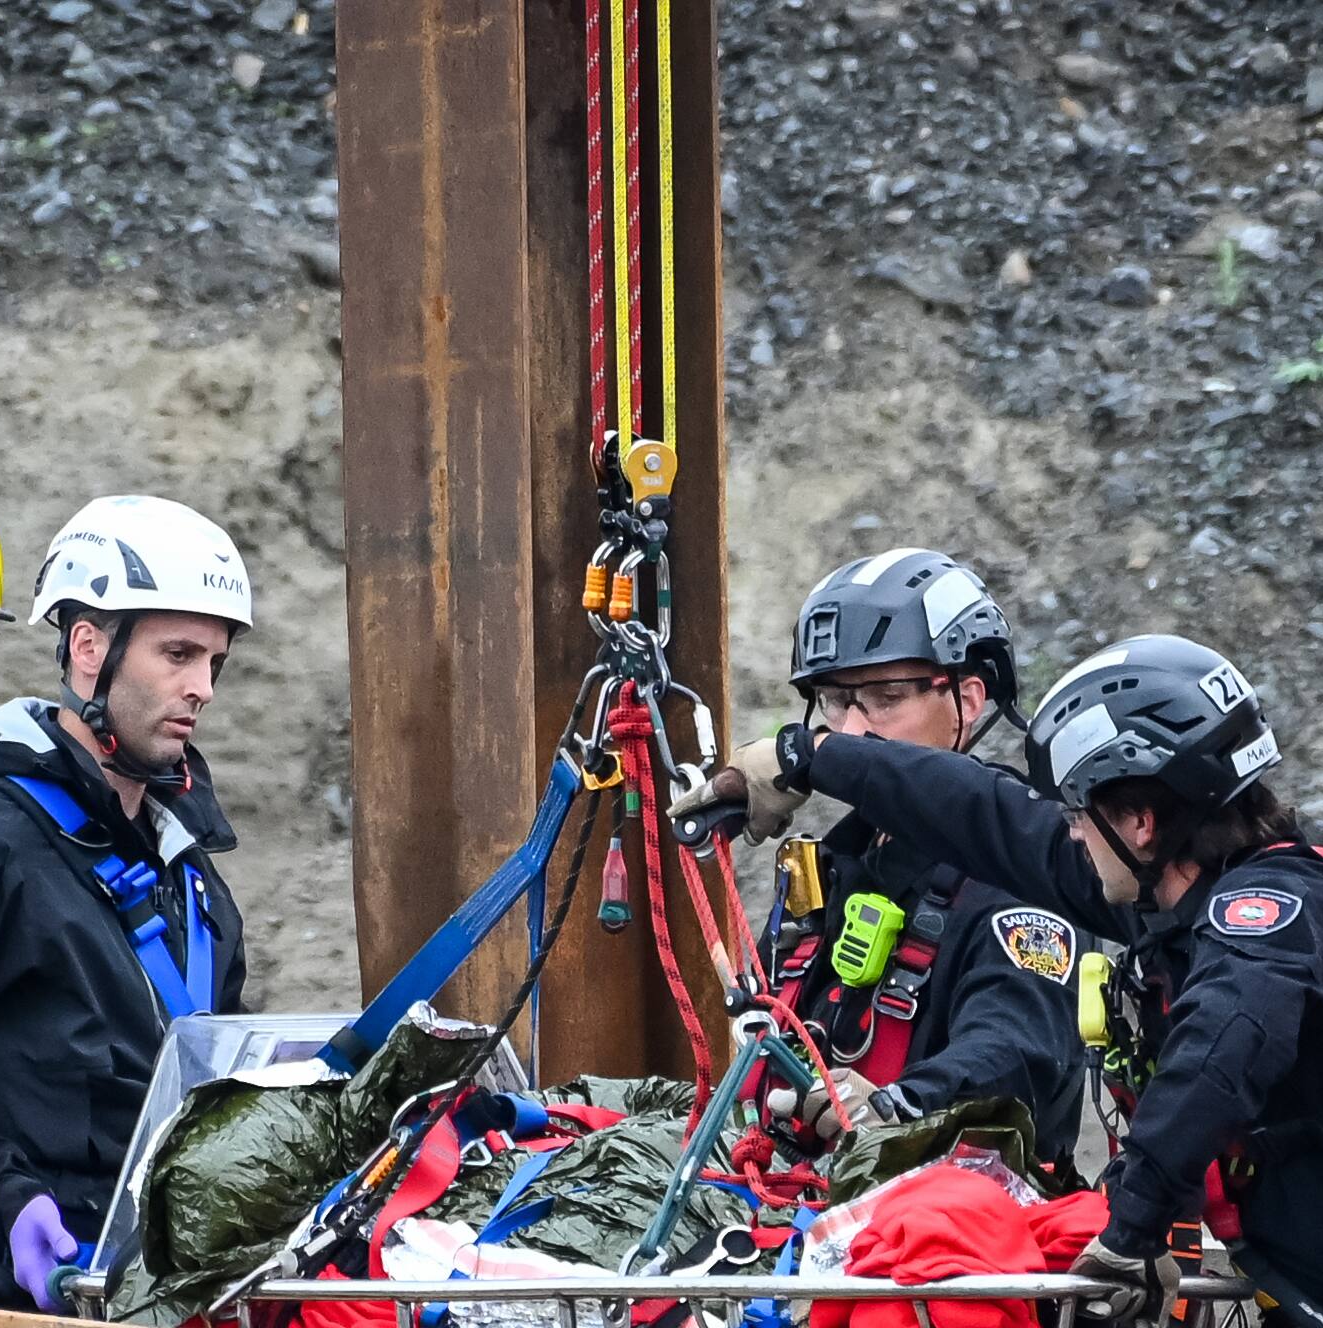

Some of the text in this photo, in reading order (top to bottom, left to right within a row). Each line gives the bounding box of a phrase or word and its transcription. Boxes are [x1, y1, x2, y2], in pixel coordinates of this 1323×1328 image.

[204, 573, 244, 596] KASK
[1208, 667, 1244, 706] 27
[1001, 914, 1066, 936] SAUVETAGE
